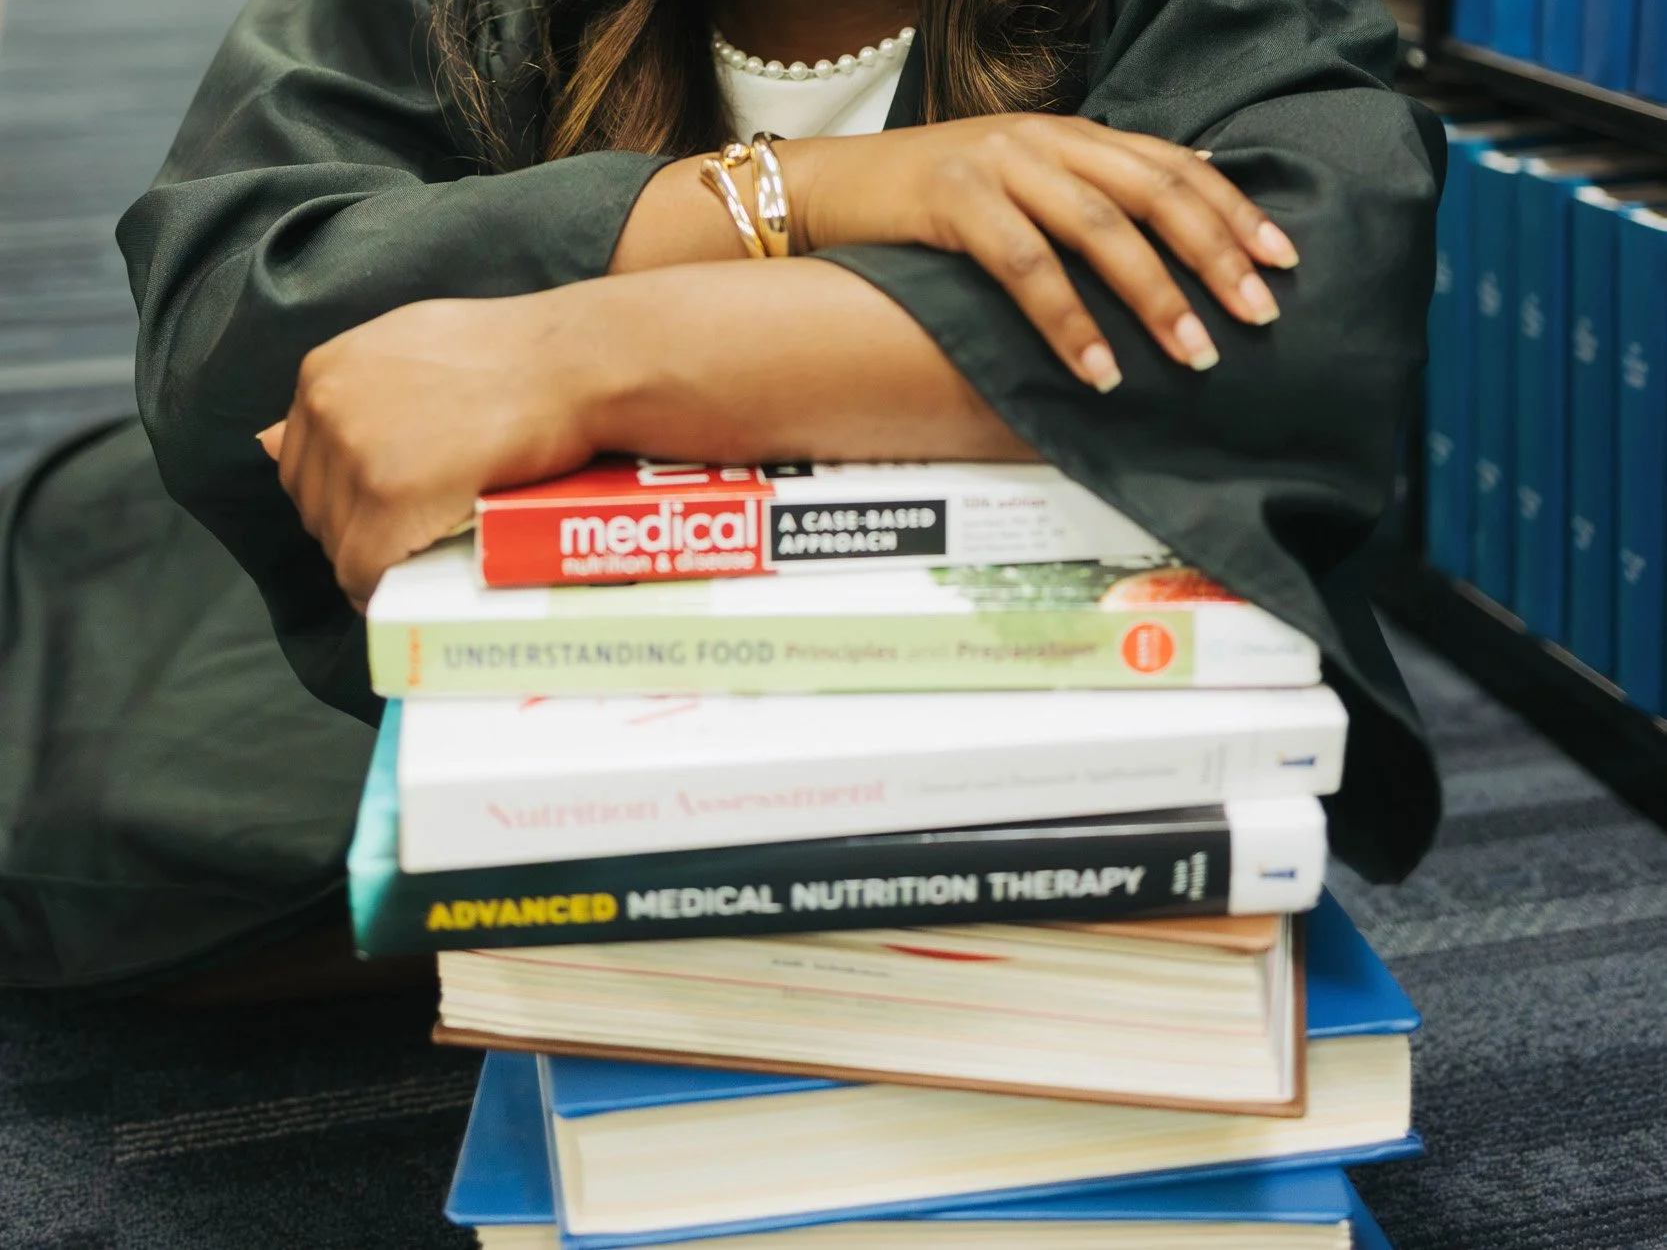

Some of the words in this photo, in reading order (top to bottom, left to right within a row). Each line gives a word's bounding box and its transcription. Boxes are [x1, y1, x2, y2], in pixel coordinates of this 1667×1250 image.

[560, 498, 758, 555] medical
[778, 511, 797, 533] A
[801, 507, 937, 533] CASE-BASED
[778, 530, 898, 555] APPROACH
[562, 553, 652, 577] nutrition
[654, 552, 672, 573] &
[674, 550, 757, 572] disease
[444, 640, 687, 669] UNDERSTANDING
[697, 640, 775, 666] FOOD
[785, 639, 898, 665] Principles
[956, 638, 1098, 664] Preparation
[486, 797, 659, 830] Nutrition
[675, 779, 887, 819] Assessment
[426, 892, 619, 931] ADVANCED
[626, 883, 783, 921] MEDICAL
[790, 873, 978, 913] NUTRITION
[985, 864, 1146, 902] THERAPY
